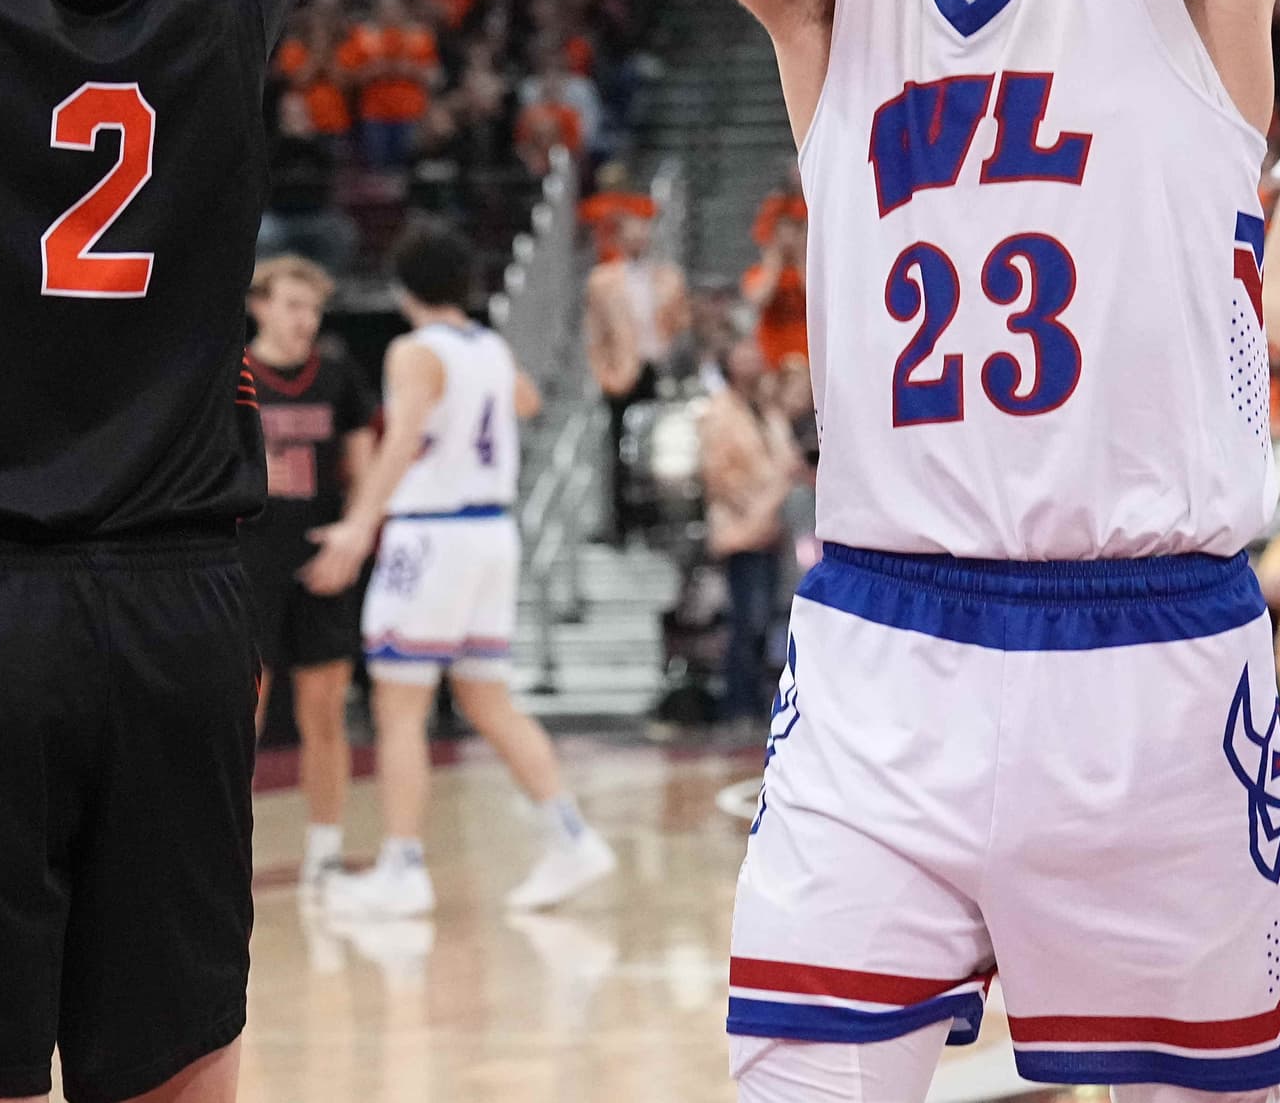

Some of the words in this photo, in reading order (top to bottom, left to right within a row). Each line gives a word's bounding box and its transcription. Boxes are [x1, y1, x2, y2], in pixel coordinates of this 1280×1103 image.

[41, 81, 156, 297] 2
[868, 71, 1092, 219] WL
[884, 232, 1082, 428] 23
